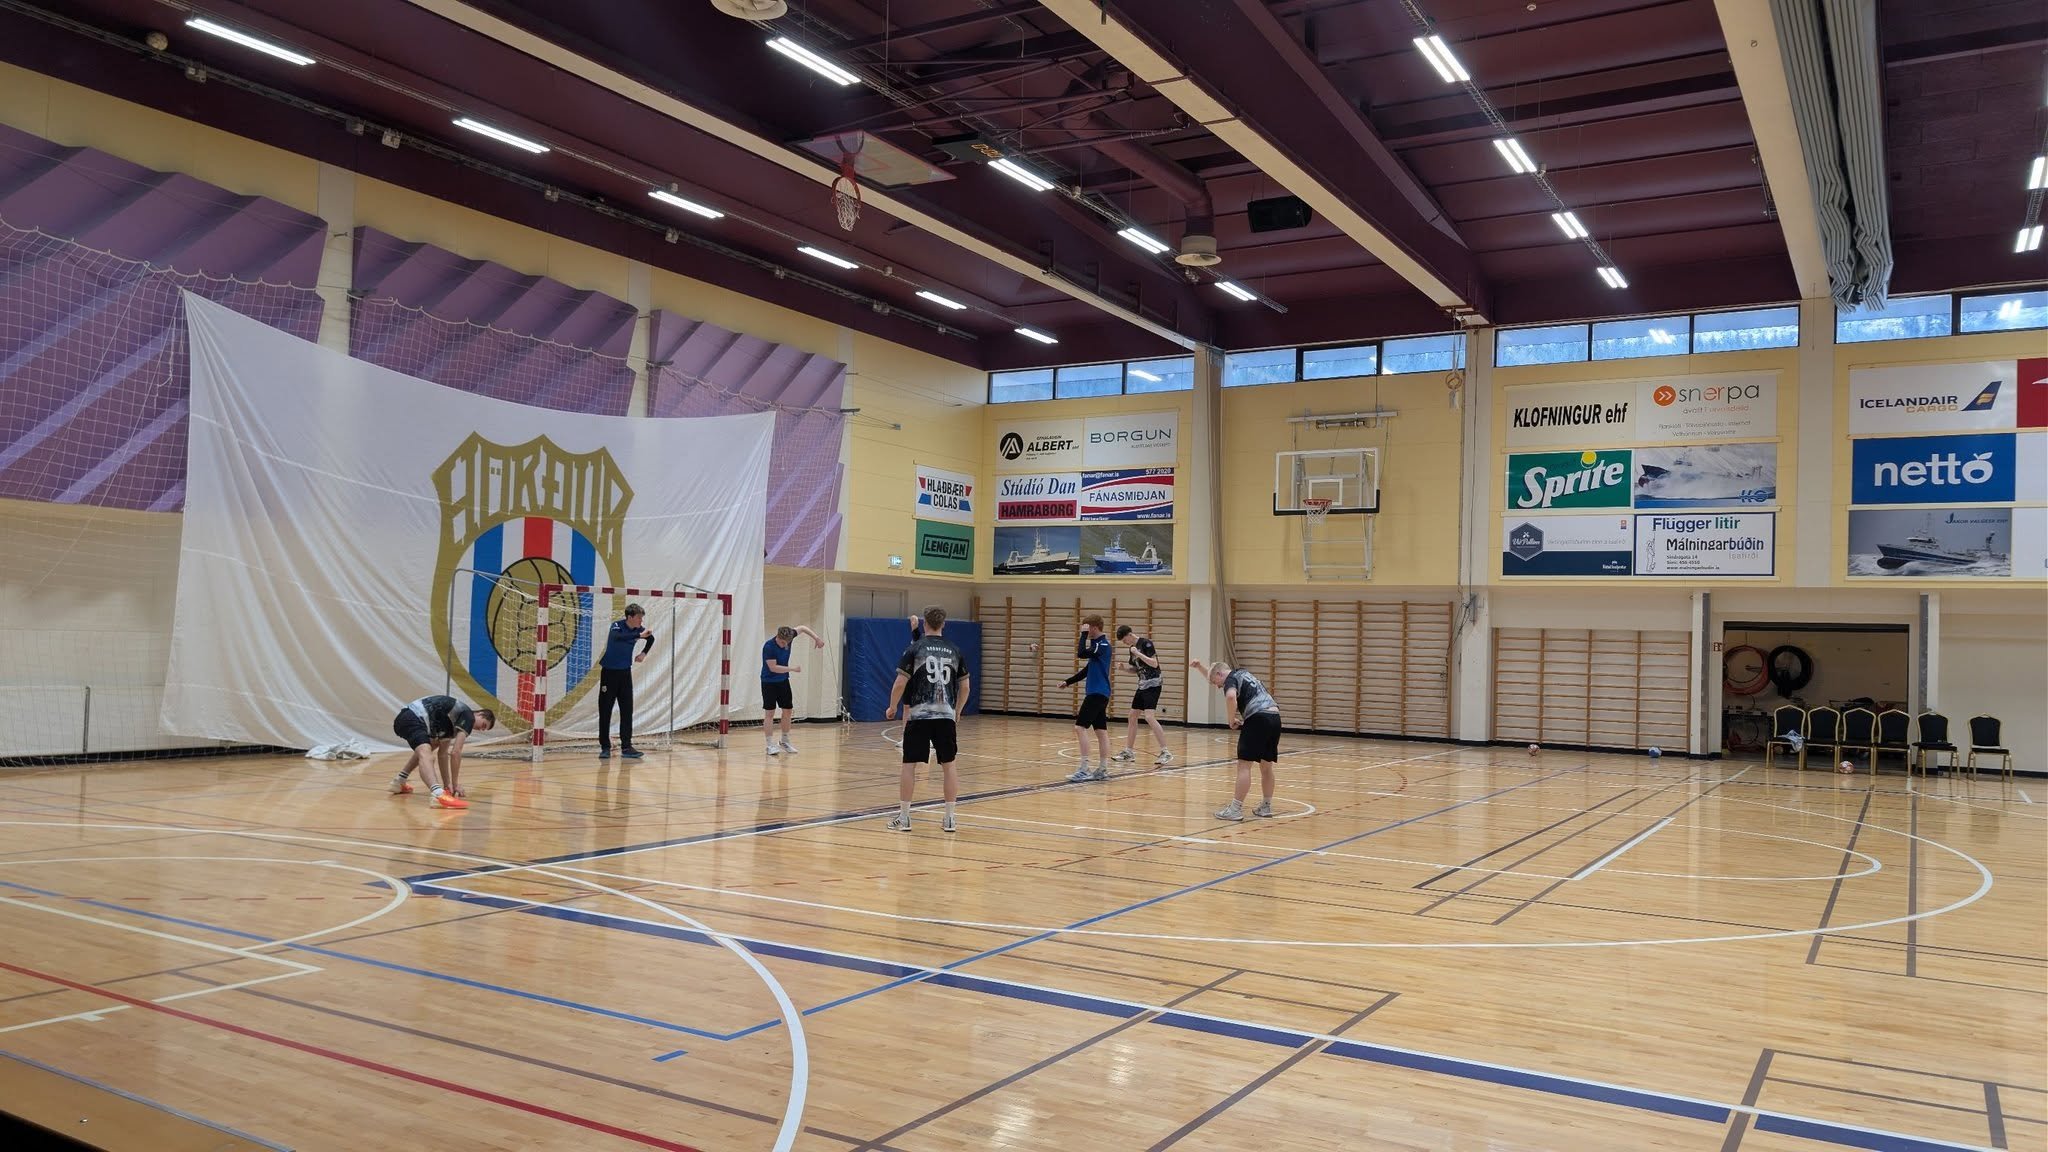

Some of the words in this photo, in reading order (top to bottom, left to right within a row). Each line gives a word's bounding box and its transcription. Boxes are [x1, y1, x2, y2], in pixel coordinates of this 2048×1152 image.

[1679, 385, 1759, 403] snerpa
[1860, 395, 1958, 409] ICELANDAIR
[1513, 404, 1600, 428] KLOFNINGUR
[1605, 403, 1628, 424] ehf
[1906, 404, 1958, 413] CARGO
[1090, 429, 1171, 443] BORGUN
[1027, 440, 1073, 453] ALBERT
[927, 478, 964, 497] HLAÐBÆR
[1001, 478, 1044, 497] Stúdíó
[1047, 477, 1076, 495] Dan
[1517, 450, 1624, 508] Sprite
[933, 493, 958, 510] COLAS
[1089, 489, 1166, 502] FÁNASMIÐJAN
[1001, 504, 1073, 517] HAMRABORG
[1137, 512, 1171, 520] www.fanar.is
[1652, 517, 1712, 533] Flügger
[1715, 516, 1740, 530] litir
[924, 539, 966, 557] LENGJAN
[1666, 536, 1764, 551] Málningarbúðin
[925, 655, 952, 685] 95
